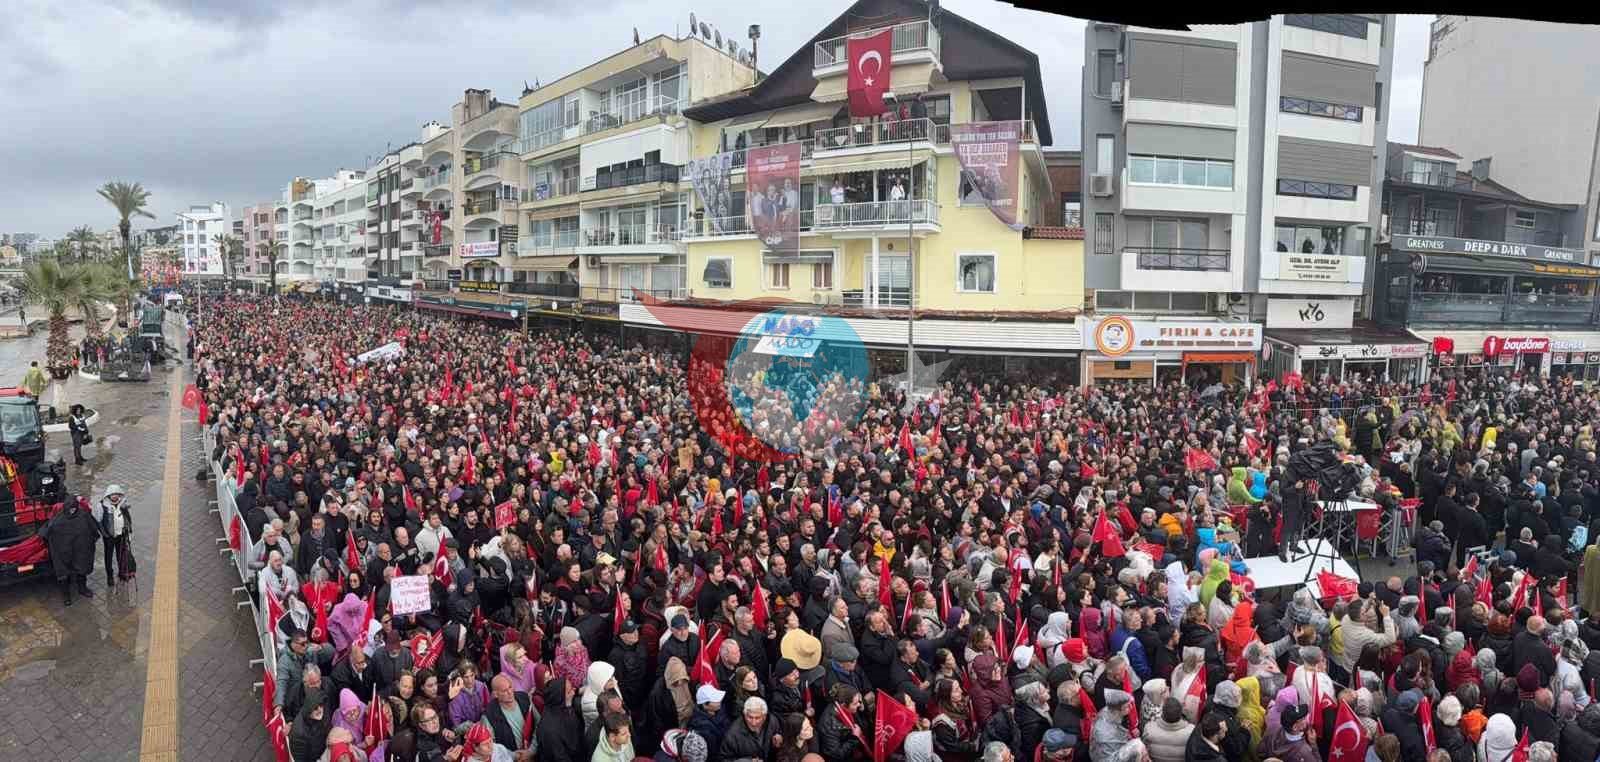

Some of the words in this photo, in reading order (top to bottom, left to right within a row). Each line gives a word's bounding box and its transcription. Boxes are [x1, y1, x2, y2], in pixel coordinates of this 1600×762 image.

[1407, 238, 1444, 249] GREATNESS
[1464, 241, 1491, 253] DEEP
[1501, 244, 1527, 256] DARK
[1160, 327, 1199, 337] FIRIN
[1219, 328, 1254, 337] CAFE
